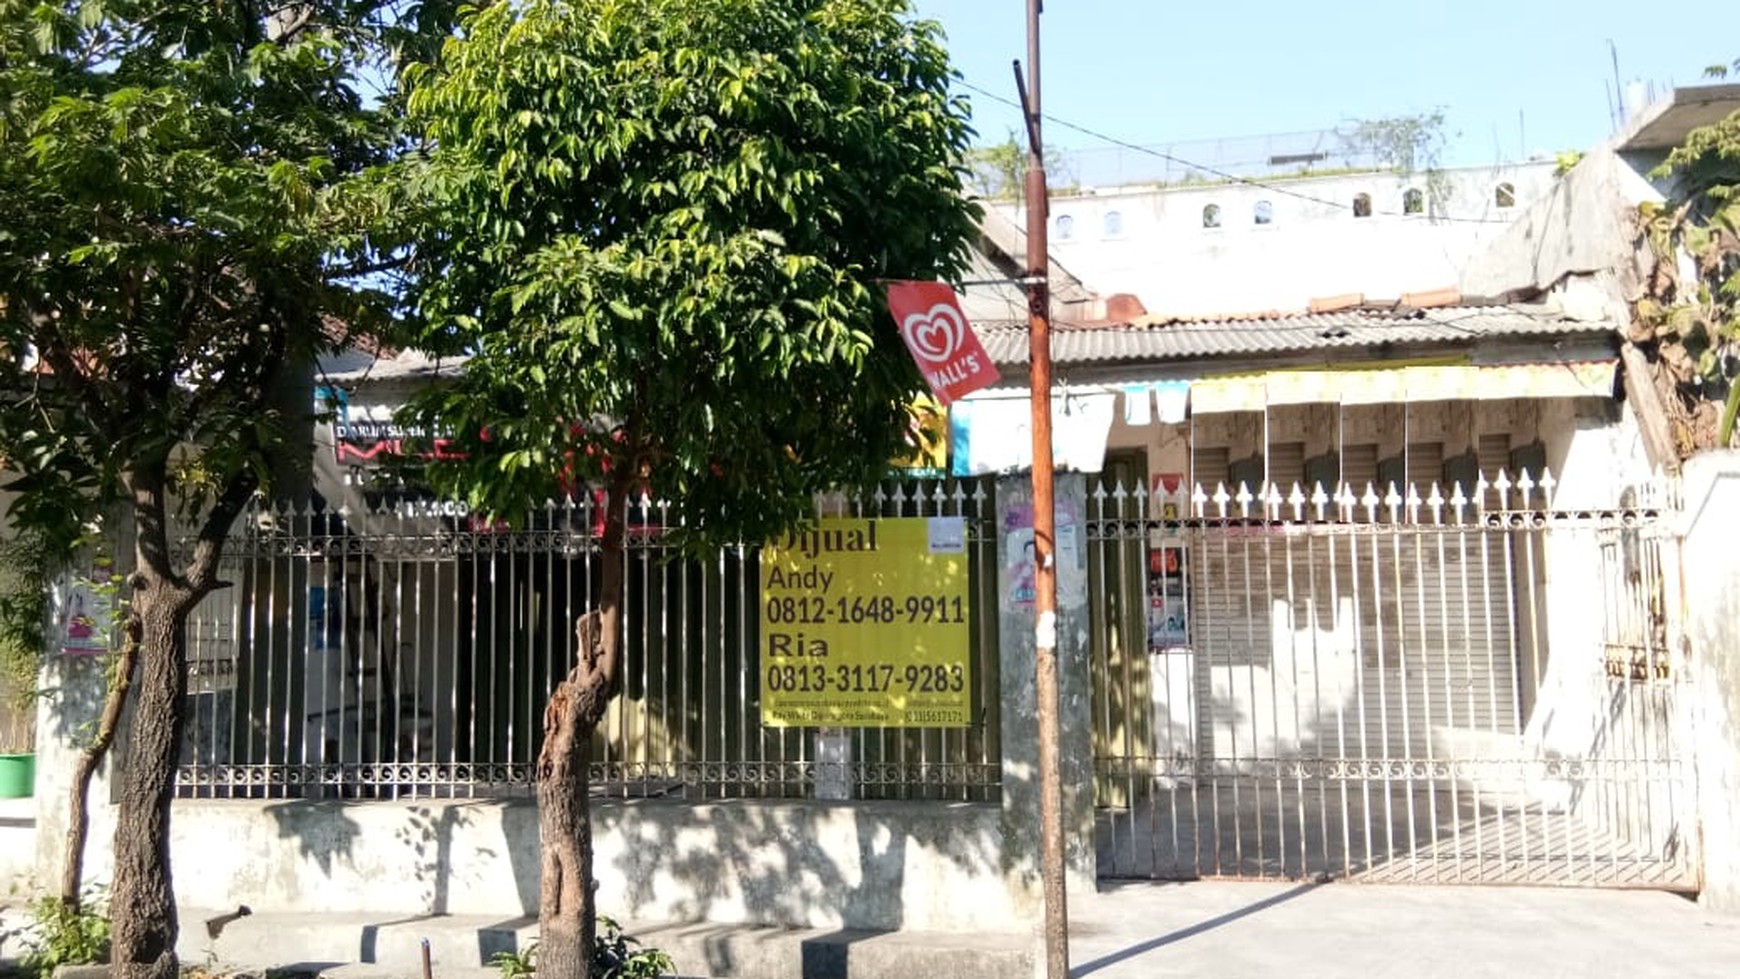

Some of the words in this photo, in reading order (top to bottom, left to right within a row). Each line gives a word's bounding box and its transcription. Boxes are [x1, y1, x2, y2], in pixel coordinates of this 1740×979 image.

[767, 565, 833, 593] Andy
[767, 595, 965, 624] 0812-1648-9911
[768, 633, 829, 658] Ria
[767, 664, 964, 692] 0813-3117-9283
